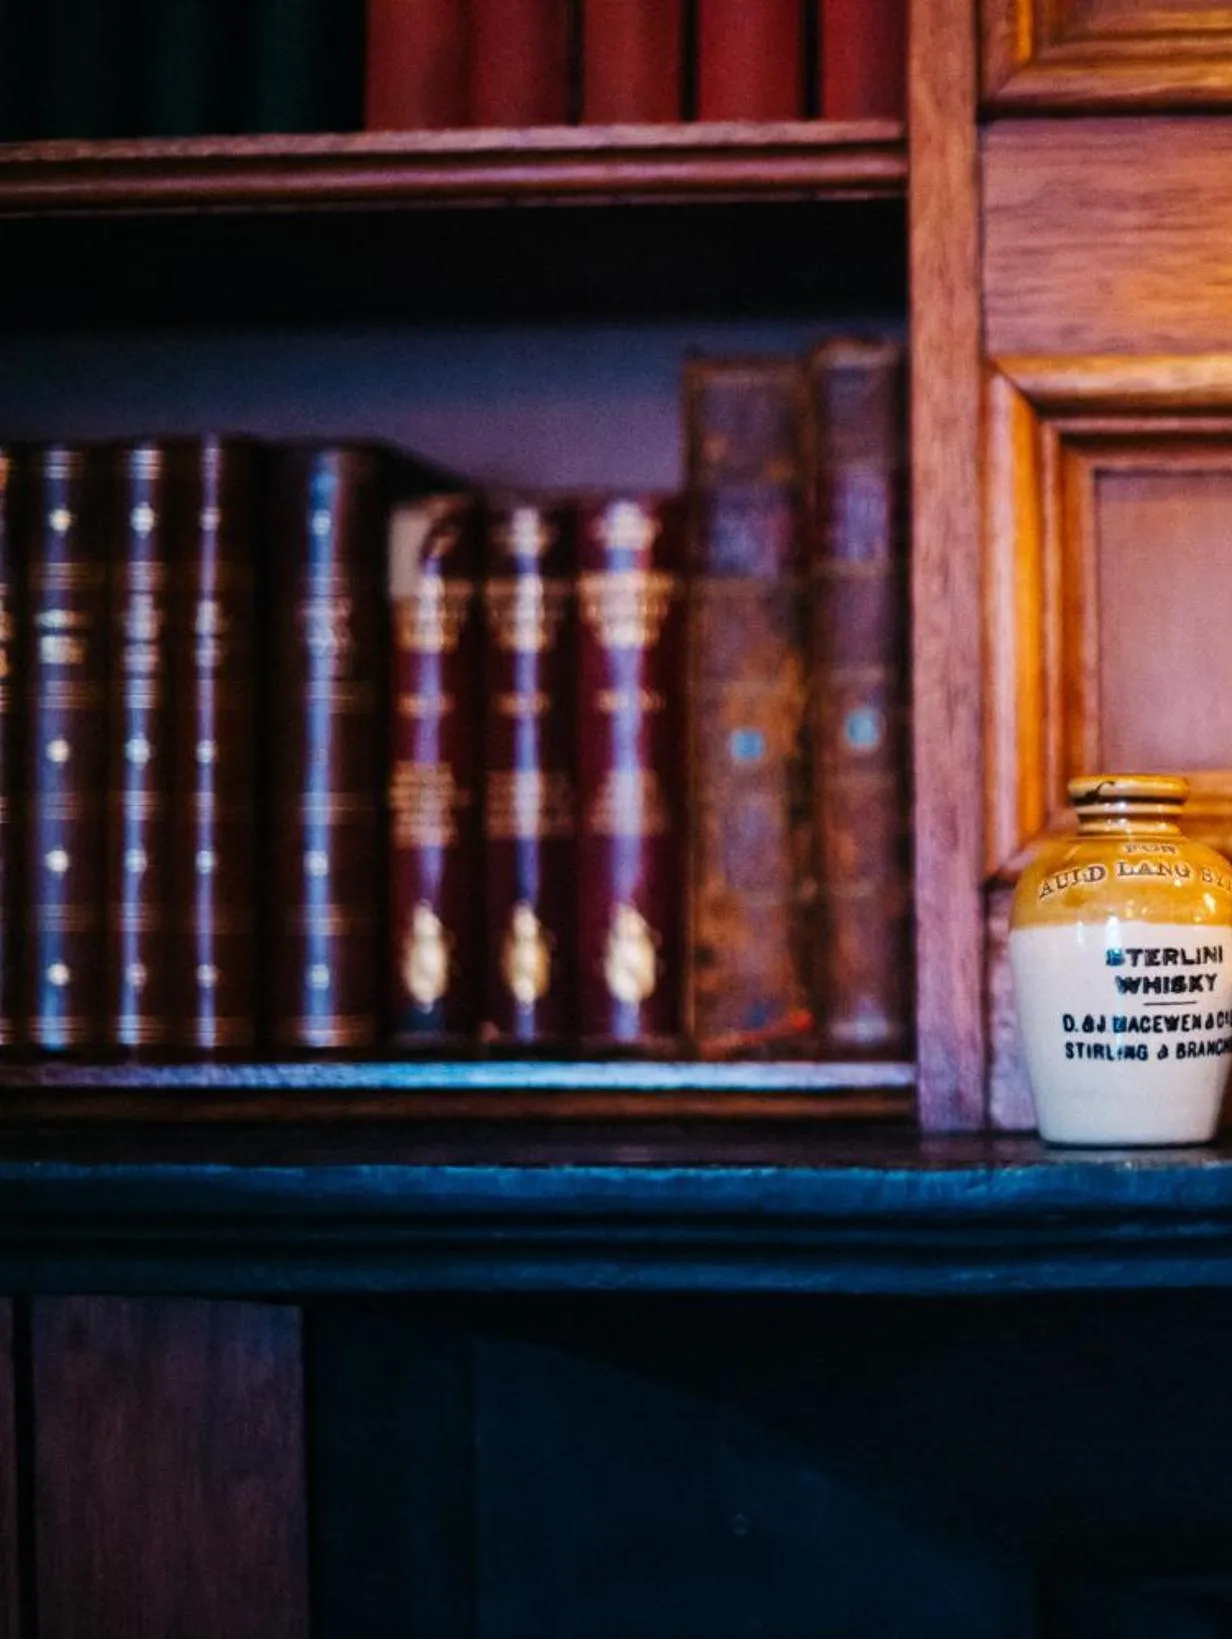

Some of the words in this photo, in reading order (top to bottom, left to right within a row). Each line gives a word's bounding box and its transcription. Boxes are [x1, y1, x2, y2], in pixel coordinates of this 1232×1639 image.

[1039, 866, 1107, 899] AULD
[1118, 861, 1191, 879] LANG
[1115, 973, 1218, 995] WHISKY
[1113, 1012, 1201, 1033] MACEWEN
[1064, 1041, 1149, 1061] STIRLING
[1157, 1043, 1169, 1060] &
